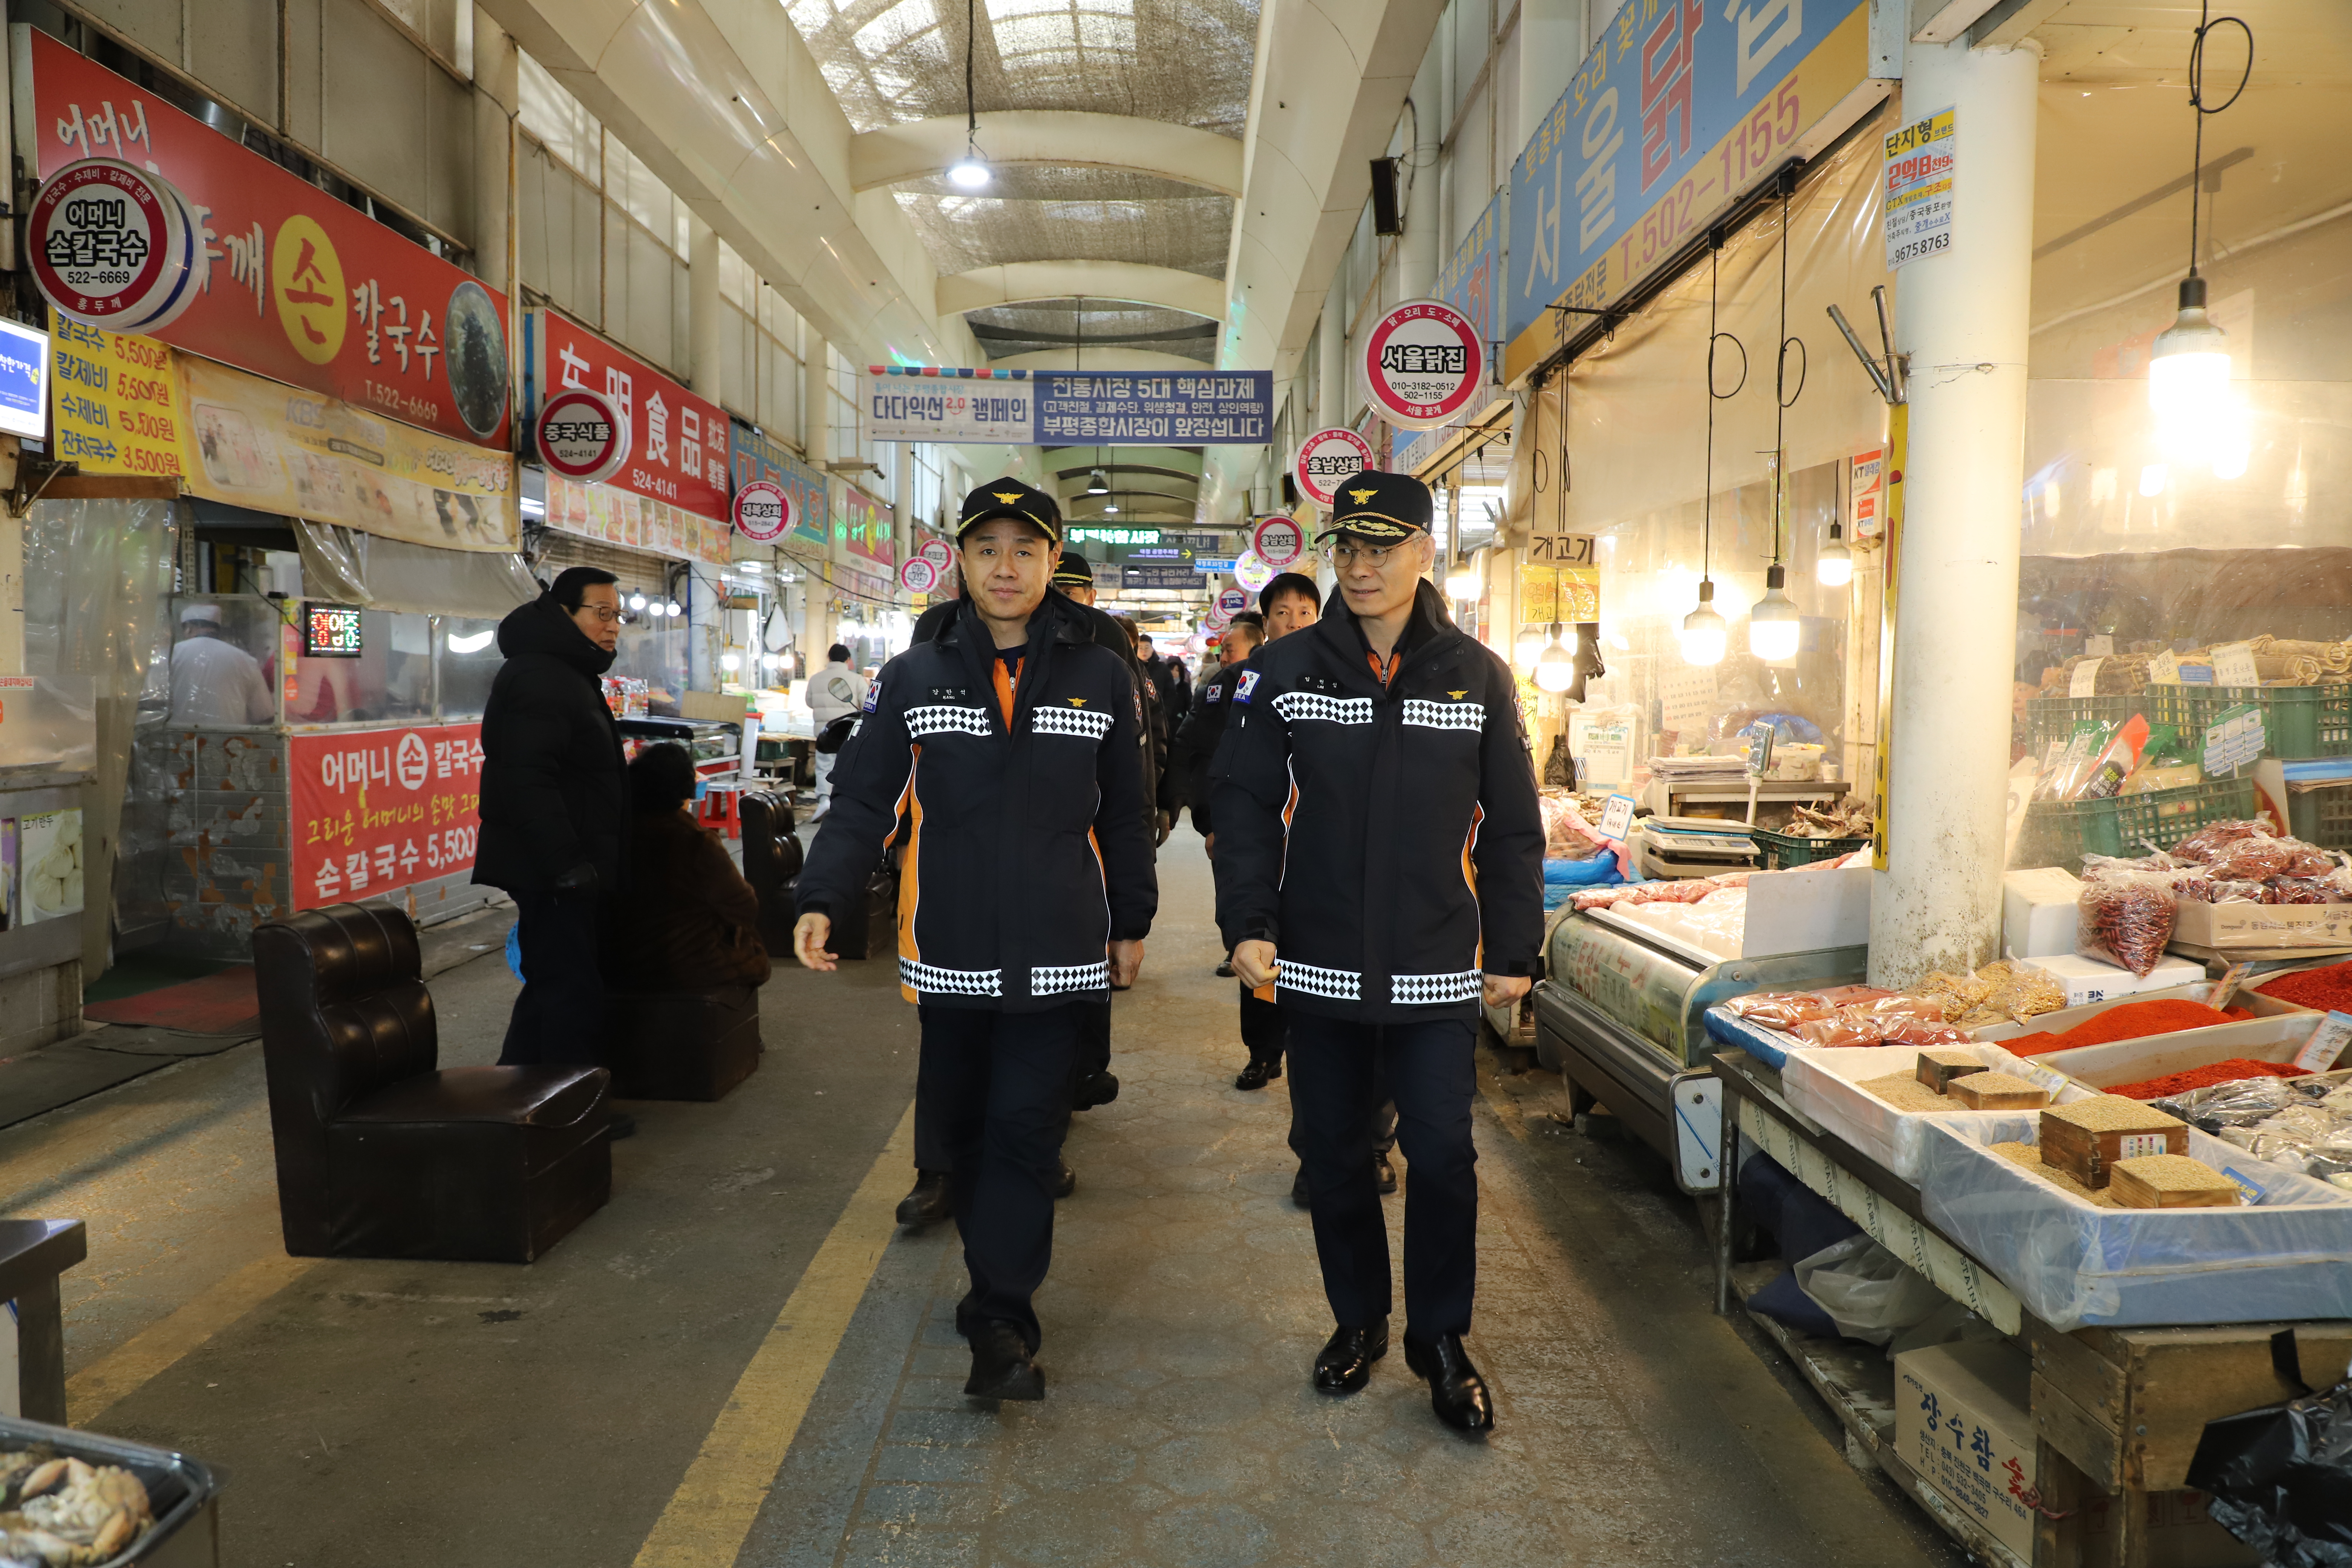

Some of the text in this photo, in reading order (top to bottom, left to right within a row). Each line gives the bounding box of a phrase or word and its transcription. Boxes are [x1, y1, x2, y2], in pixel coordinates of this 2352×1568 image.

[57, 100, 152, 161] 어머니
[1886, 118, 1954, 158] 단지형 브랜드
[1620, 75, 1800, 281] T.502-1155
[1886, 195, 1903, 211] GTX
[1925, 182, 1942, 197] 구조
[67, 201, 123, 227] 어머니
[46, 232, 146, 265] 손칼국수
[68, 271, 130, 283] 522-6669
[285, 237, 439, 381] 손 칼국수
[57, 313, 105, 352] 칼국수
[57, 351, 107, 391] 칼제비
[1381, 345, 1467, 372] 서울닭집
[1053, 378, 1255, 399] 전통시장 5대 핵심과제
[1392, 382, 1455, 390] 010-3182-0512
[1404, 391, 1442, 400] 502-1155
[61, 392, 109, 429] 수제비
[365, 380, 438, 421] T.522-6669
[873, 395, 1026, 422] 다다익선 2.0 캠페인
[1406, 404, 1442, 416] 서울 꽃게
[544, 423, 610, 441] 중국식품
[1043, 417, 1168, 437] 부평종합시장이
[1175, 417, 1264, 438] 앞장섭니다
[61, 429, 181, 476] 잔치국수 3,500원
[559, 449, 597, 458] 524-4141
[1308, 457, 1363, 474] 호남상회
[633, 469, 677, 500] 524-4141
[1854, 467, 1864, 479] KT
[742, 504, 782, 518] 대복상회
[1261, 535, 1296, 546] 충남상회
[1533, 536, 1594, 565] 개고기
[322, 738, 486, 794] 어머니 손 칼국수
[1609, 801, 1629, 815] 개고기
[23, 815, 54, 830] 고기만두
[307, 809, 355, 846] 그리운
[427, 825, 478, 870] 5,500
[1941, 1446, 1952, 1463] 충북
[1954, 1455, 1971, 1477] 진천군
[1942, 1462, 1954, 1479] 043)
